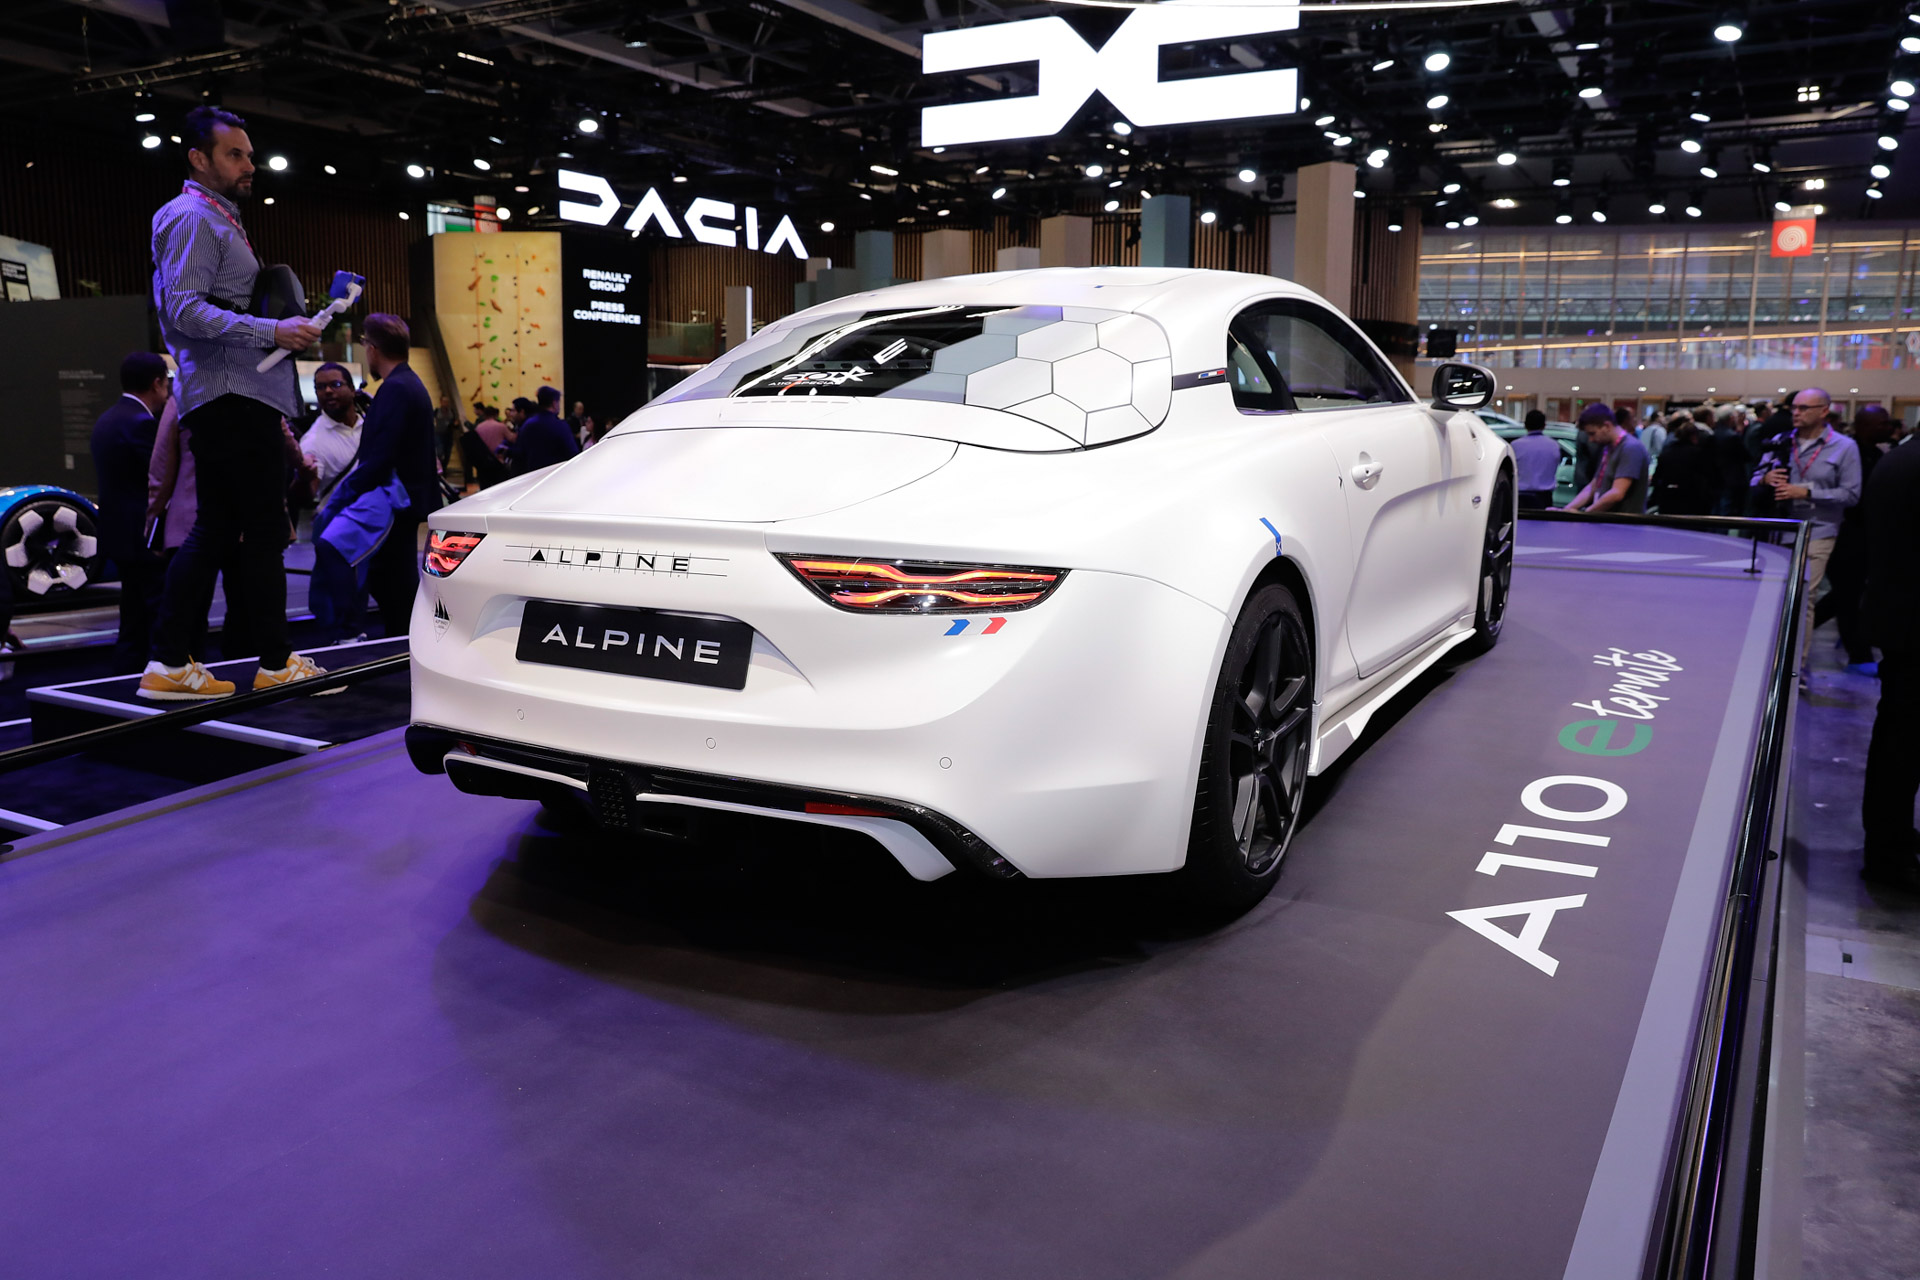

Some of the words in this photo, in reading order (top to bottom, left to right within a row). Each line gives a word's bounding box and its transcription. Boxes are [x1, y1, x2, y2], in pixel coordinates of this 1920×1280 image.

[558, 168, 809, 260] DACIA
[582, 268, 632, 284] RENAULT
[589, 280, 626, 293] GROUP
[590, 300, 625, 313] PRESS
[573, 309, 641, 325] CONFERENCE
[531, 549, 689, 572] ALPINE
[541, 623, 721, 665] ALPINE
[1445, 775, 1628, 978] A110
